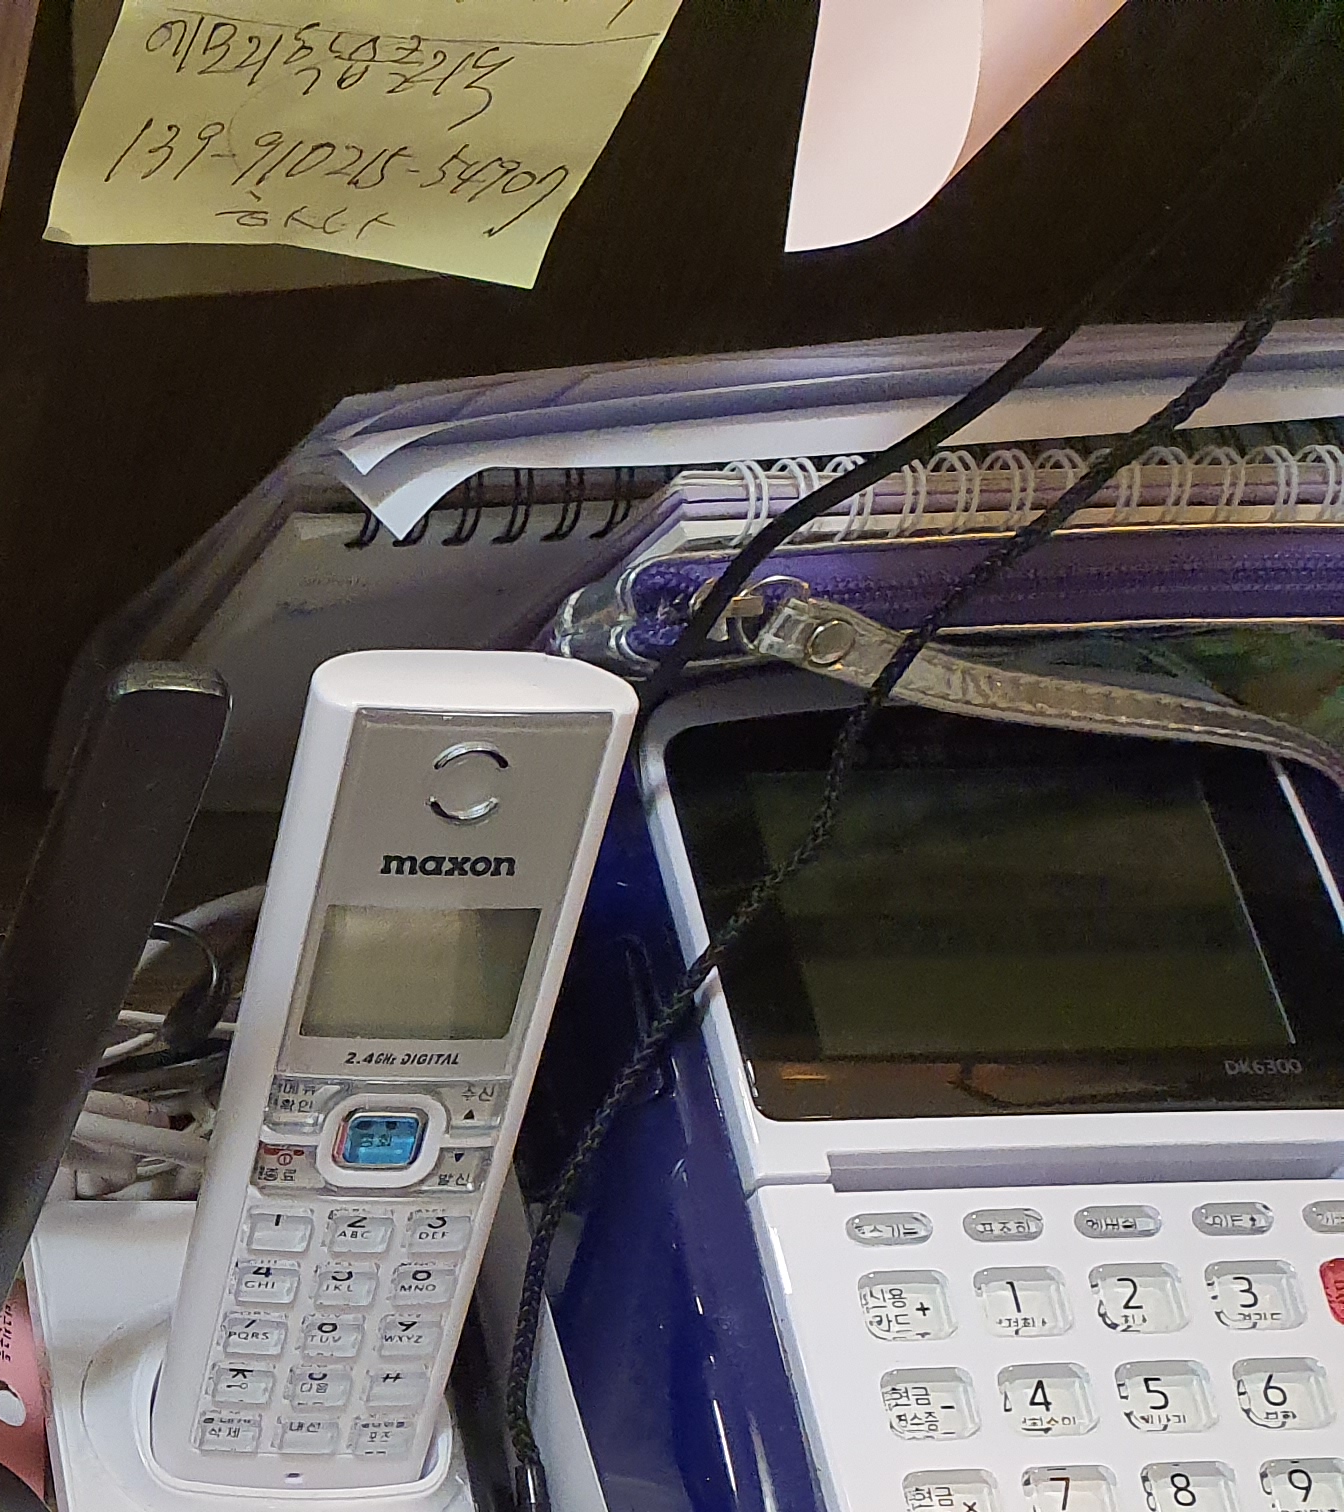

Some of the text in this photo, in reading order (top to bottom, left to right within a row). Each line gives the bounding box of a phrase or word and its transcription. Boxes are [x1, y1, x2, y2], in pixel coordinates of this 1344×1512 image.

[379, 853, 517, 877] maxon
[400, 1051, 460, 1066] DIGITAL
[1224, 1058, 1303, 1075] DK6300
[1005, 1280, 1022, 1313] 1
[1116, 1277, 1144, 1310] 2
[1232, 1276, 1259, 1308] 3
[1028, 1379, 1052, 1412] 4
[1143, 1377, 1170, 1410] 5
[1262, 1373, 1288, 1407] 6
[1049, 1476, 1070, 1511] 7
[1170, 1472, 1197, 1507] 8
[1287, 1468, 1313, 1503] 9
